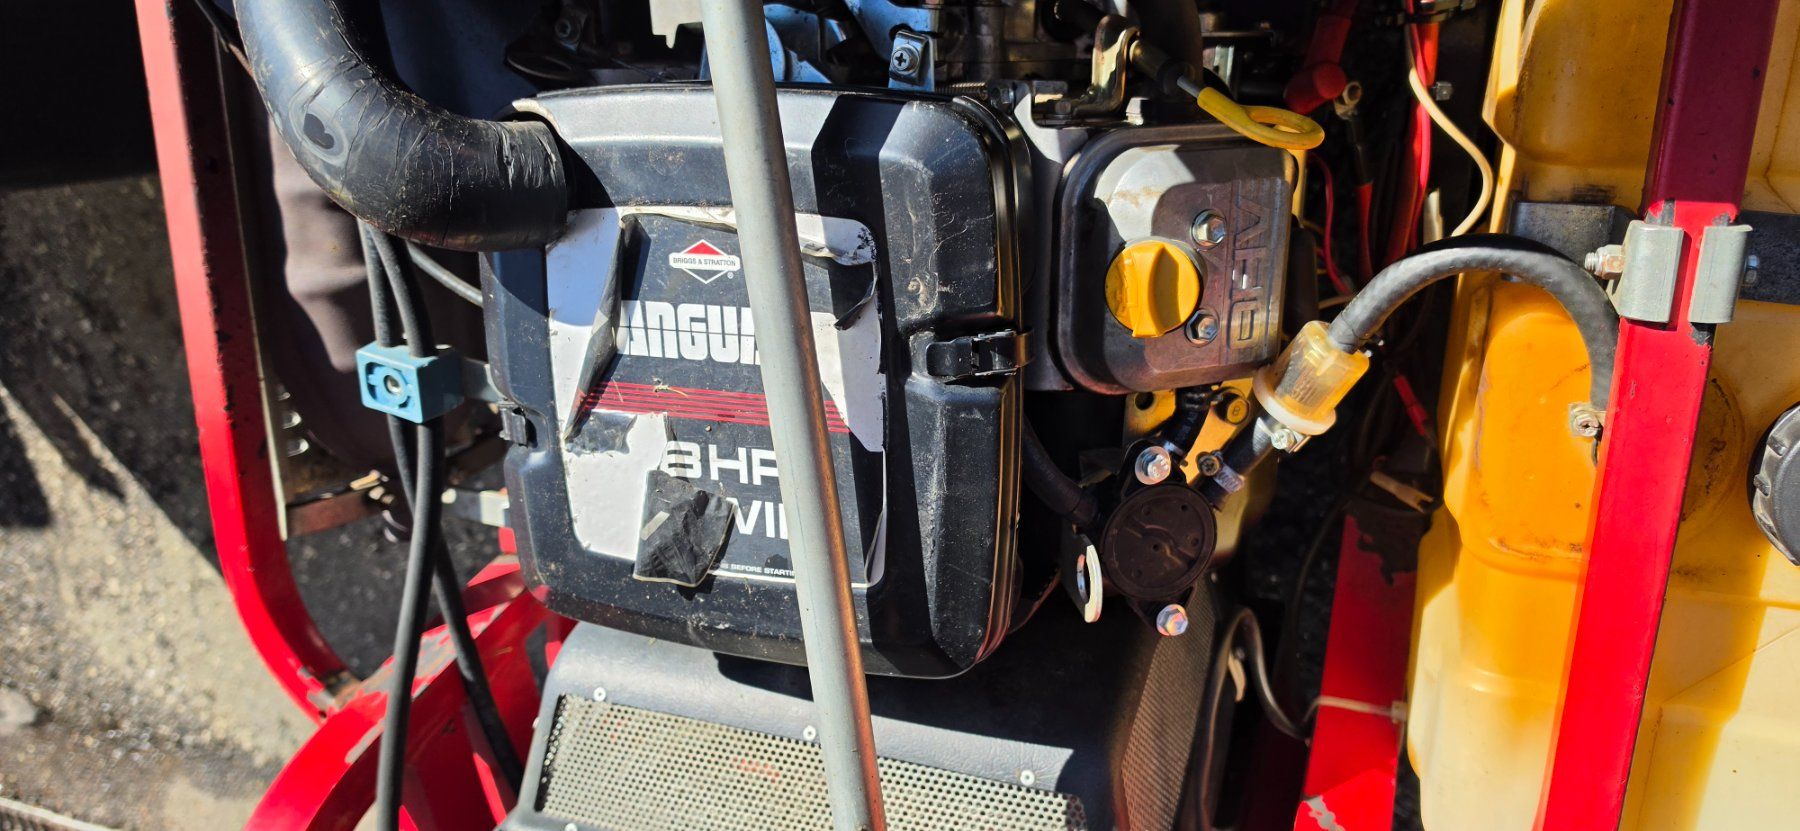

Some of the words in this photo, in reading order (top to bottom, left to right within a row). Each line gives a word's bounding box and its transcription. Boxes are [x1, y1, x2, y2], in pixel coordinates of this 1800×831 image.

[672, 256, 697, 265] BRIGGS
[697, 258, 703, 266] &
[703, 258, 736, 267] STRATTON
[731, 563, 762, 573] BEFORE
